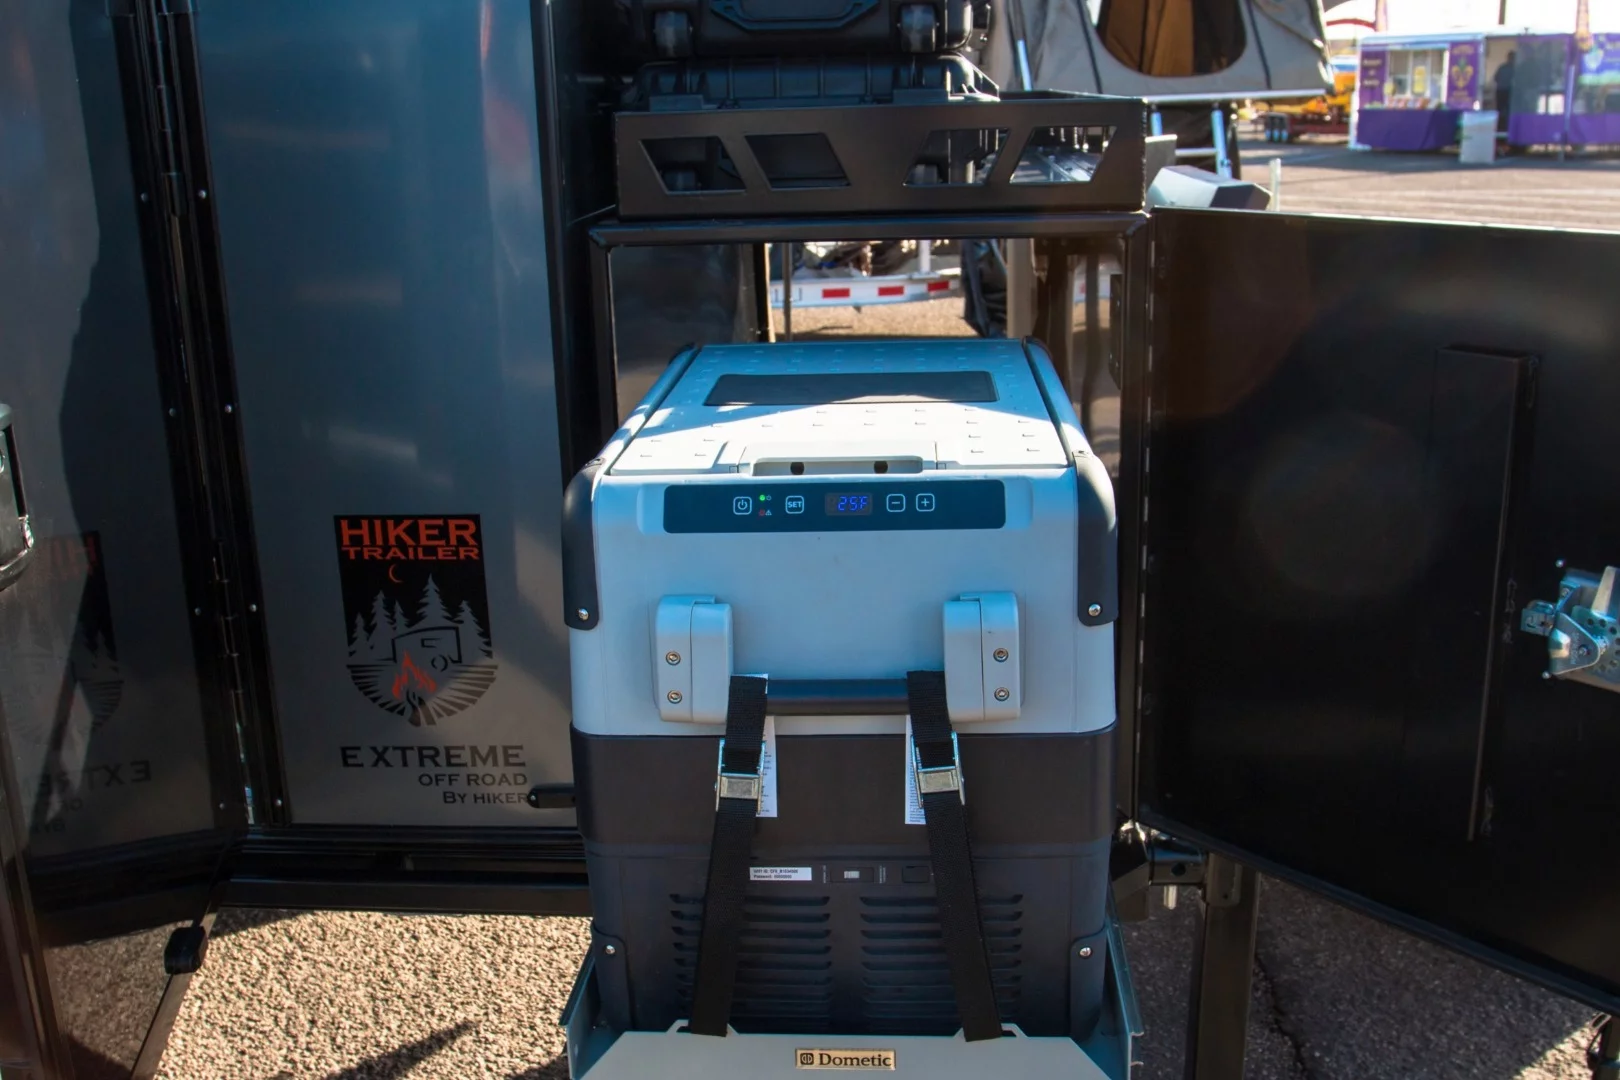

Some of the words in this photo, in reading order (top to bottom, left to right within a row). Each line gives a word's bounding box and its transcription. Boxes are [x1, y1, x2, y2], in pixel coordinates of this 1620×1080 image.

[838, 496, 868, 511] 25F
[340, 518, 479, 546] HIKER
[341, 546, 480, 560] TRAILER
[340, 744, 526, 768] EXTREME
[418, 773, 461, 786] OFF
[467, 773, 528, 786] ROAD
[473, 792, 530, 804] HIKER
[818, 1052, 892, 1067] Dometic
